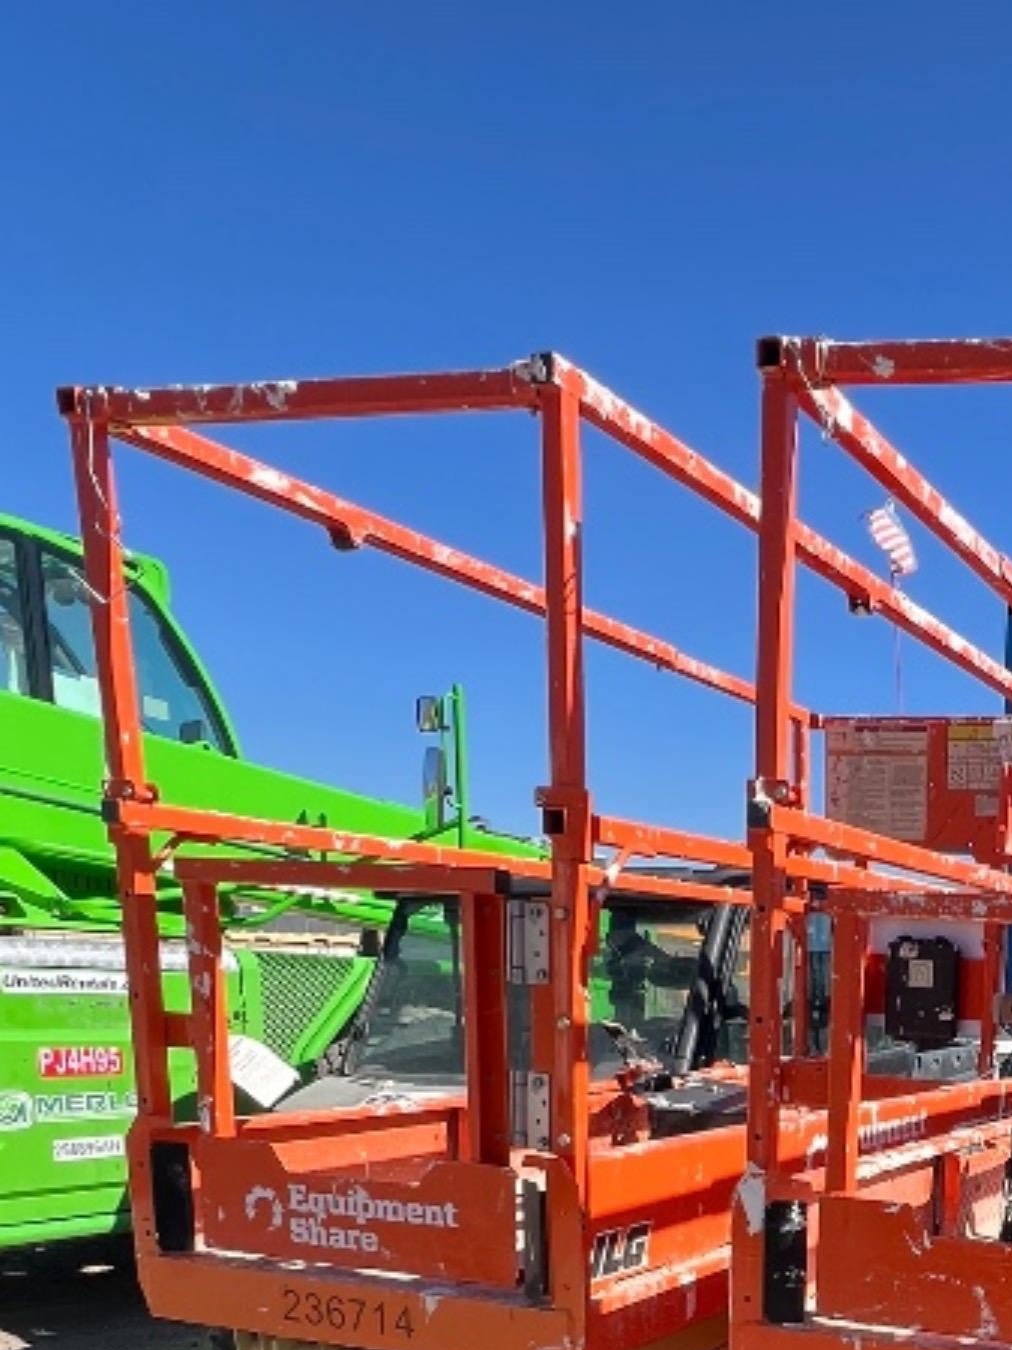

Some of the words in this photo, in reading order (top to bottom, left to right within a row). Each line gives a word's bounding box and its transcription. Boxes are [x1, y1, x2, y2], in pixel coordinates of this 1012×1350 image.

[288, 1184, 459, 1228] Equipment
[290, 1217, 378, 1252] Share
[283, 1288, 414, 1339] 236714
